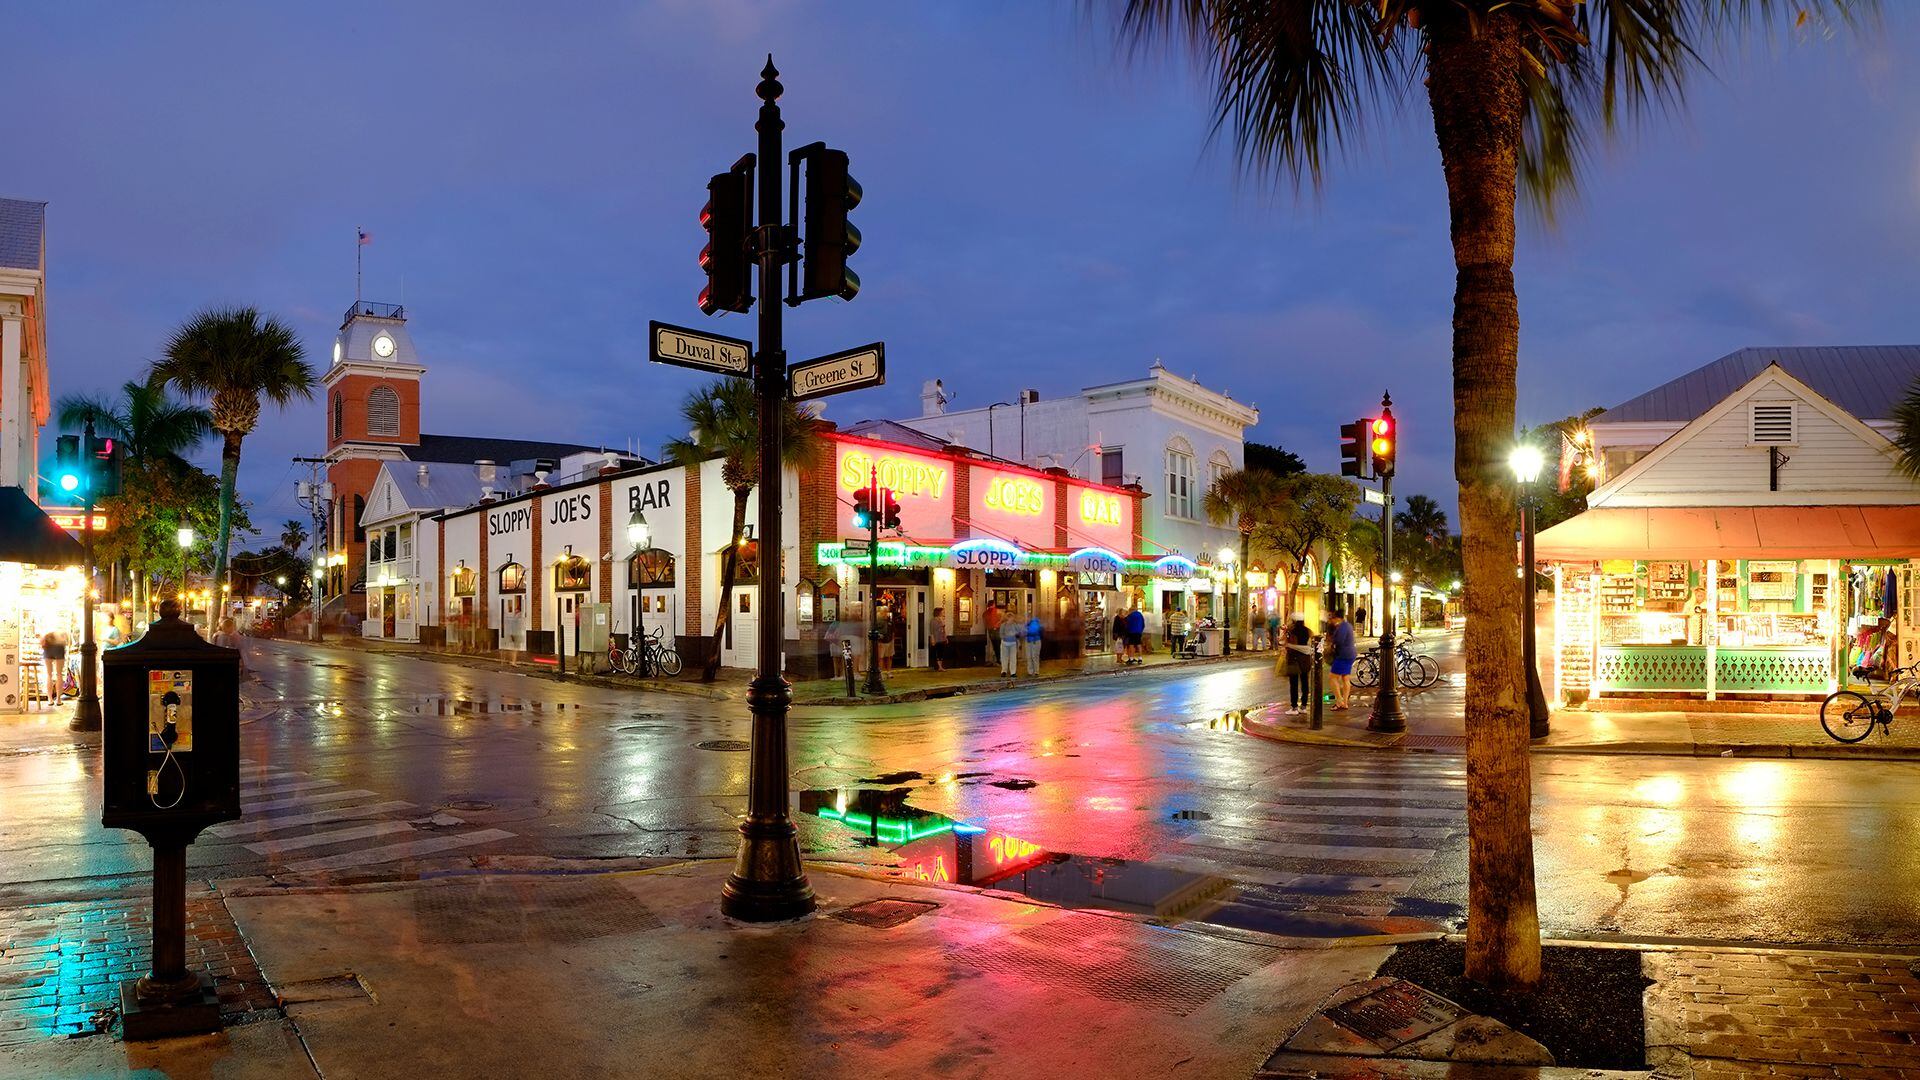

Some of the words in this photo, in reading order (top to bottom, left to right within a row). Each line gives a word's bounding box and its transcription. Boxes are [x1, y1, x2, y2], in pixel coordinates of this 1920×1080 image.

[675, 337, 715, 361] Duval
[719, 346, 733, 364] St
[804, 368, 847, 388] Greene
[850, 360, 864, 377] St
[843, 451, 945, 498] SLOPPY
[986, 478, 1042, 513] JOE'S
[1081, 496, 1121, 525] BAR
[489, 506, 532, 537] SLOPPY
[551, 494, 592, 526] JOE'S
[628, 479, 671, 513] BAR
[956, 548, 1018, 566] SLOPPY
[1083, 557, 1118, 573] JOE'S
[1166, 563, 1185, 576] BAR
